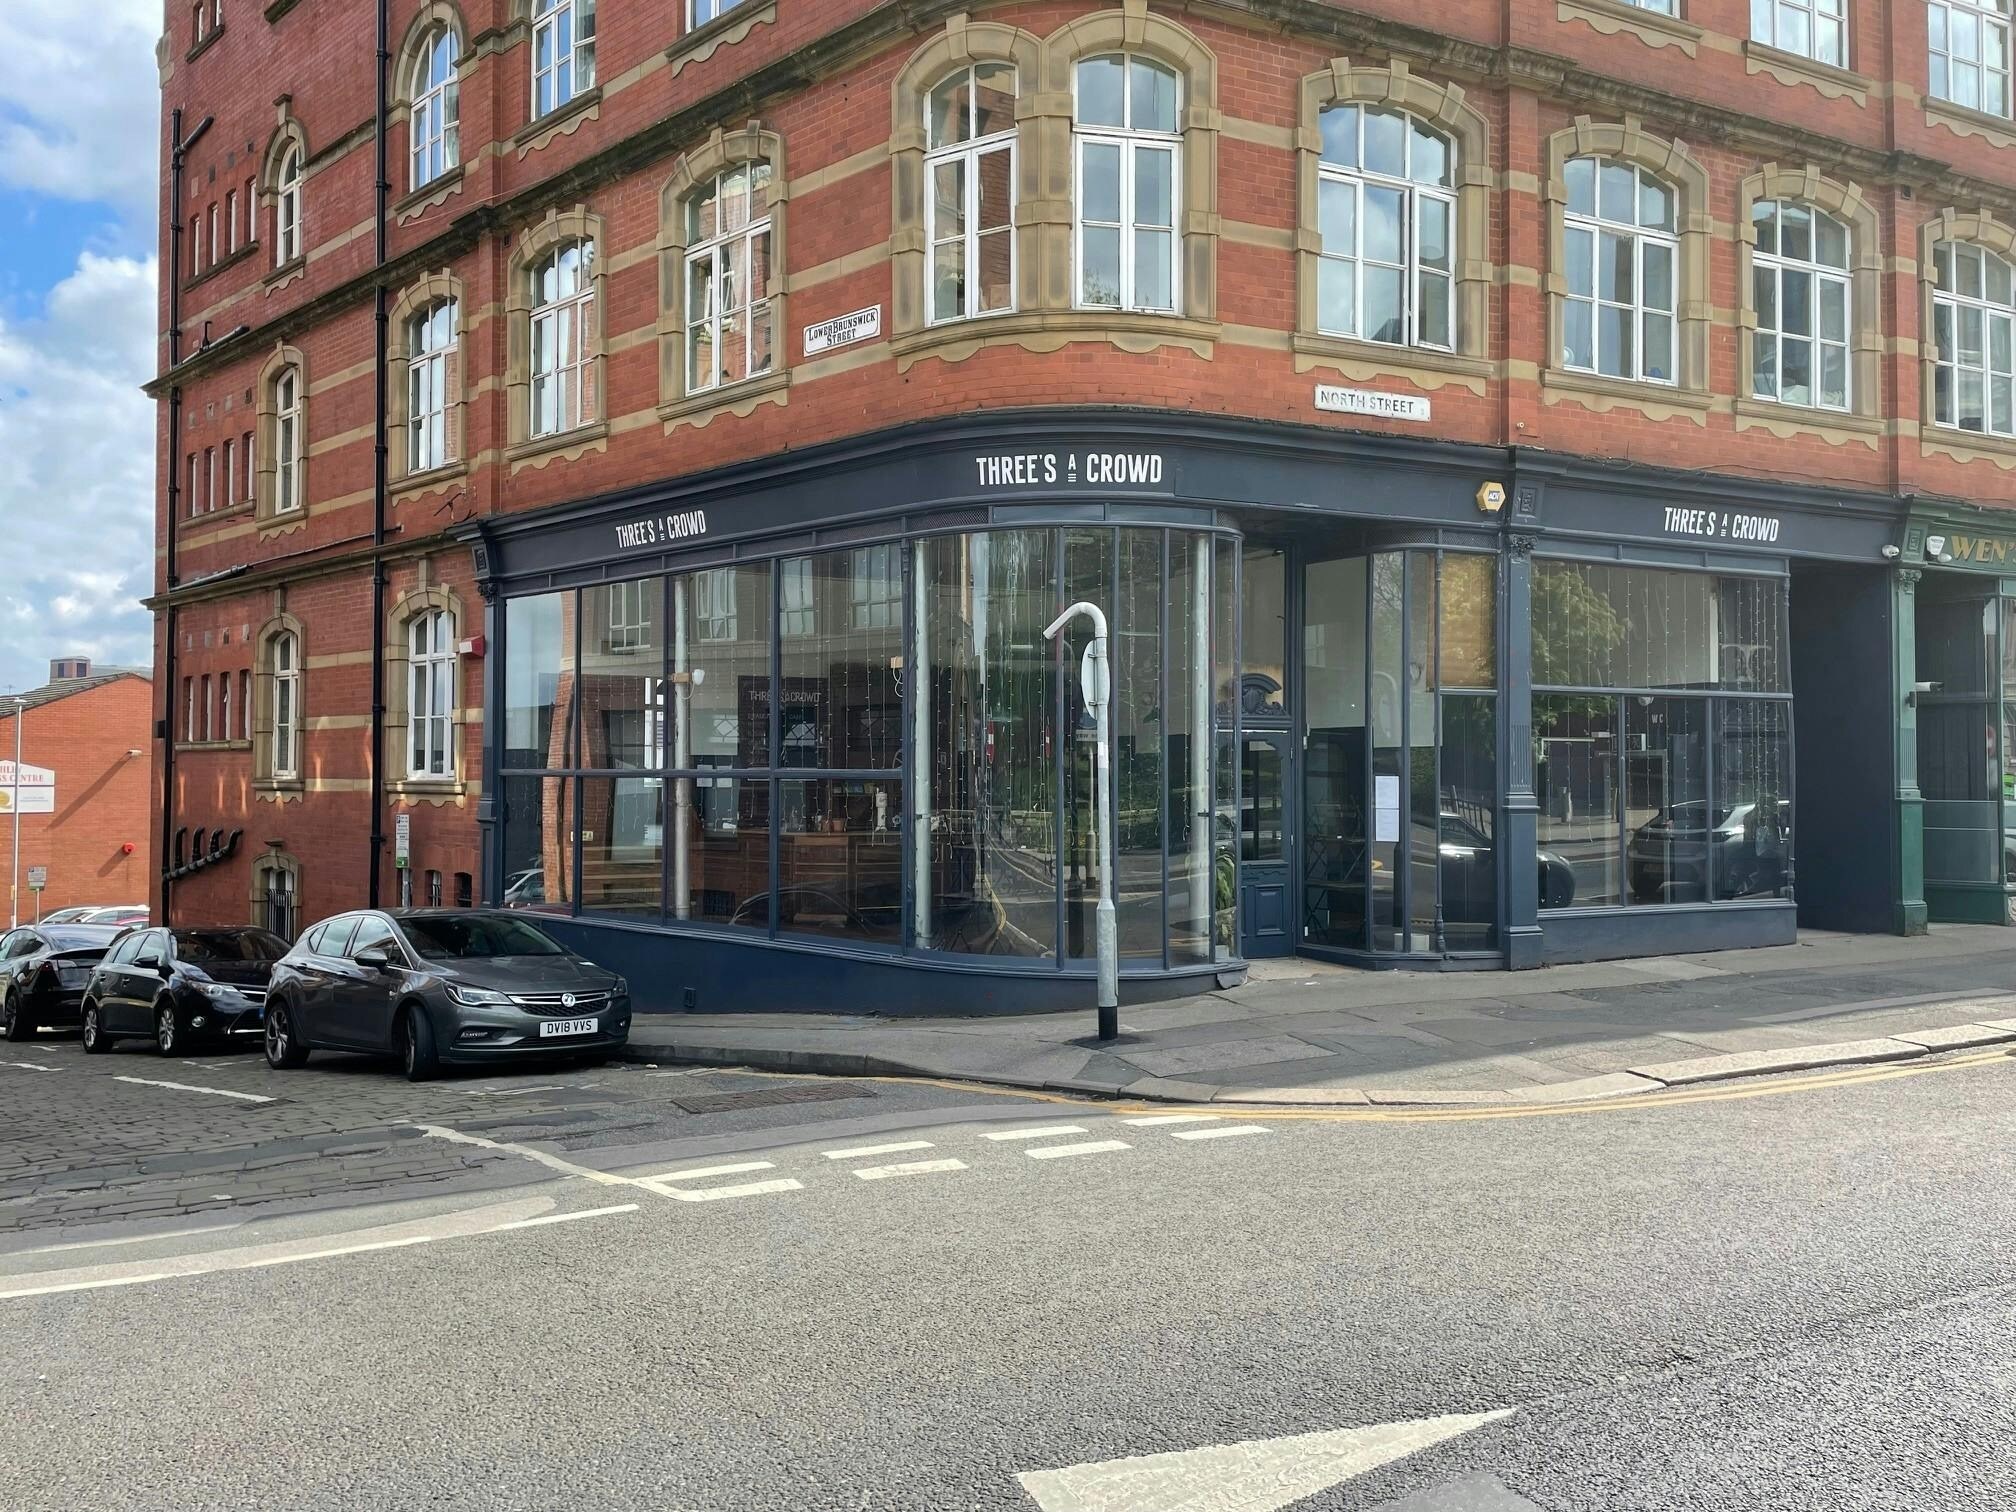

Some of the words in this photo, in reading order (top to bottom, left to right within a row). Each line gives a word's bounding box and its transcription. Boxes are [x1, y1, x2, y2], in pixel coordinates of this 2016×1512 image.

[826, 328, 857, 346] STREET
[1321, 390, 1365, 408] NORTH
[1369, 396, 1415, 413] STREET
[976, 453, 1056, 486] THREE'S
[1068, 454, 1076, 470] A
[1086, 453, 1162, 483] CROWD
[616, 519, 655, 548] THREE'S
[668, 510, 706, 540] CROWD
[1732, 514, 1779, 542] CROWD
[547, 1022, 570, 1034] DV18
[574, 1020, 592, 1032] VVS
